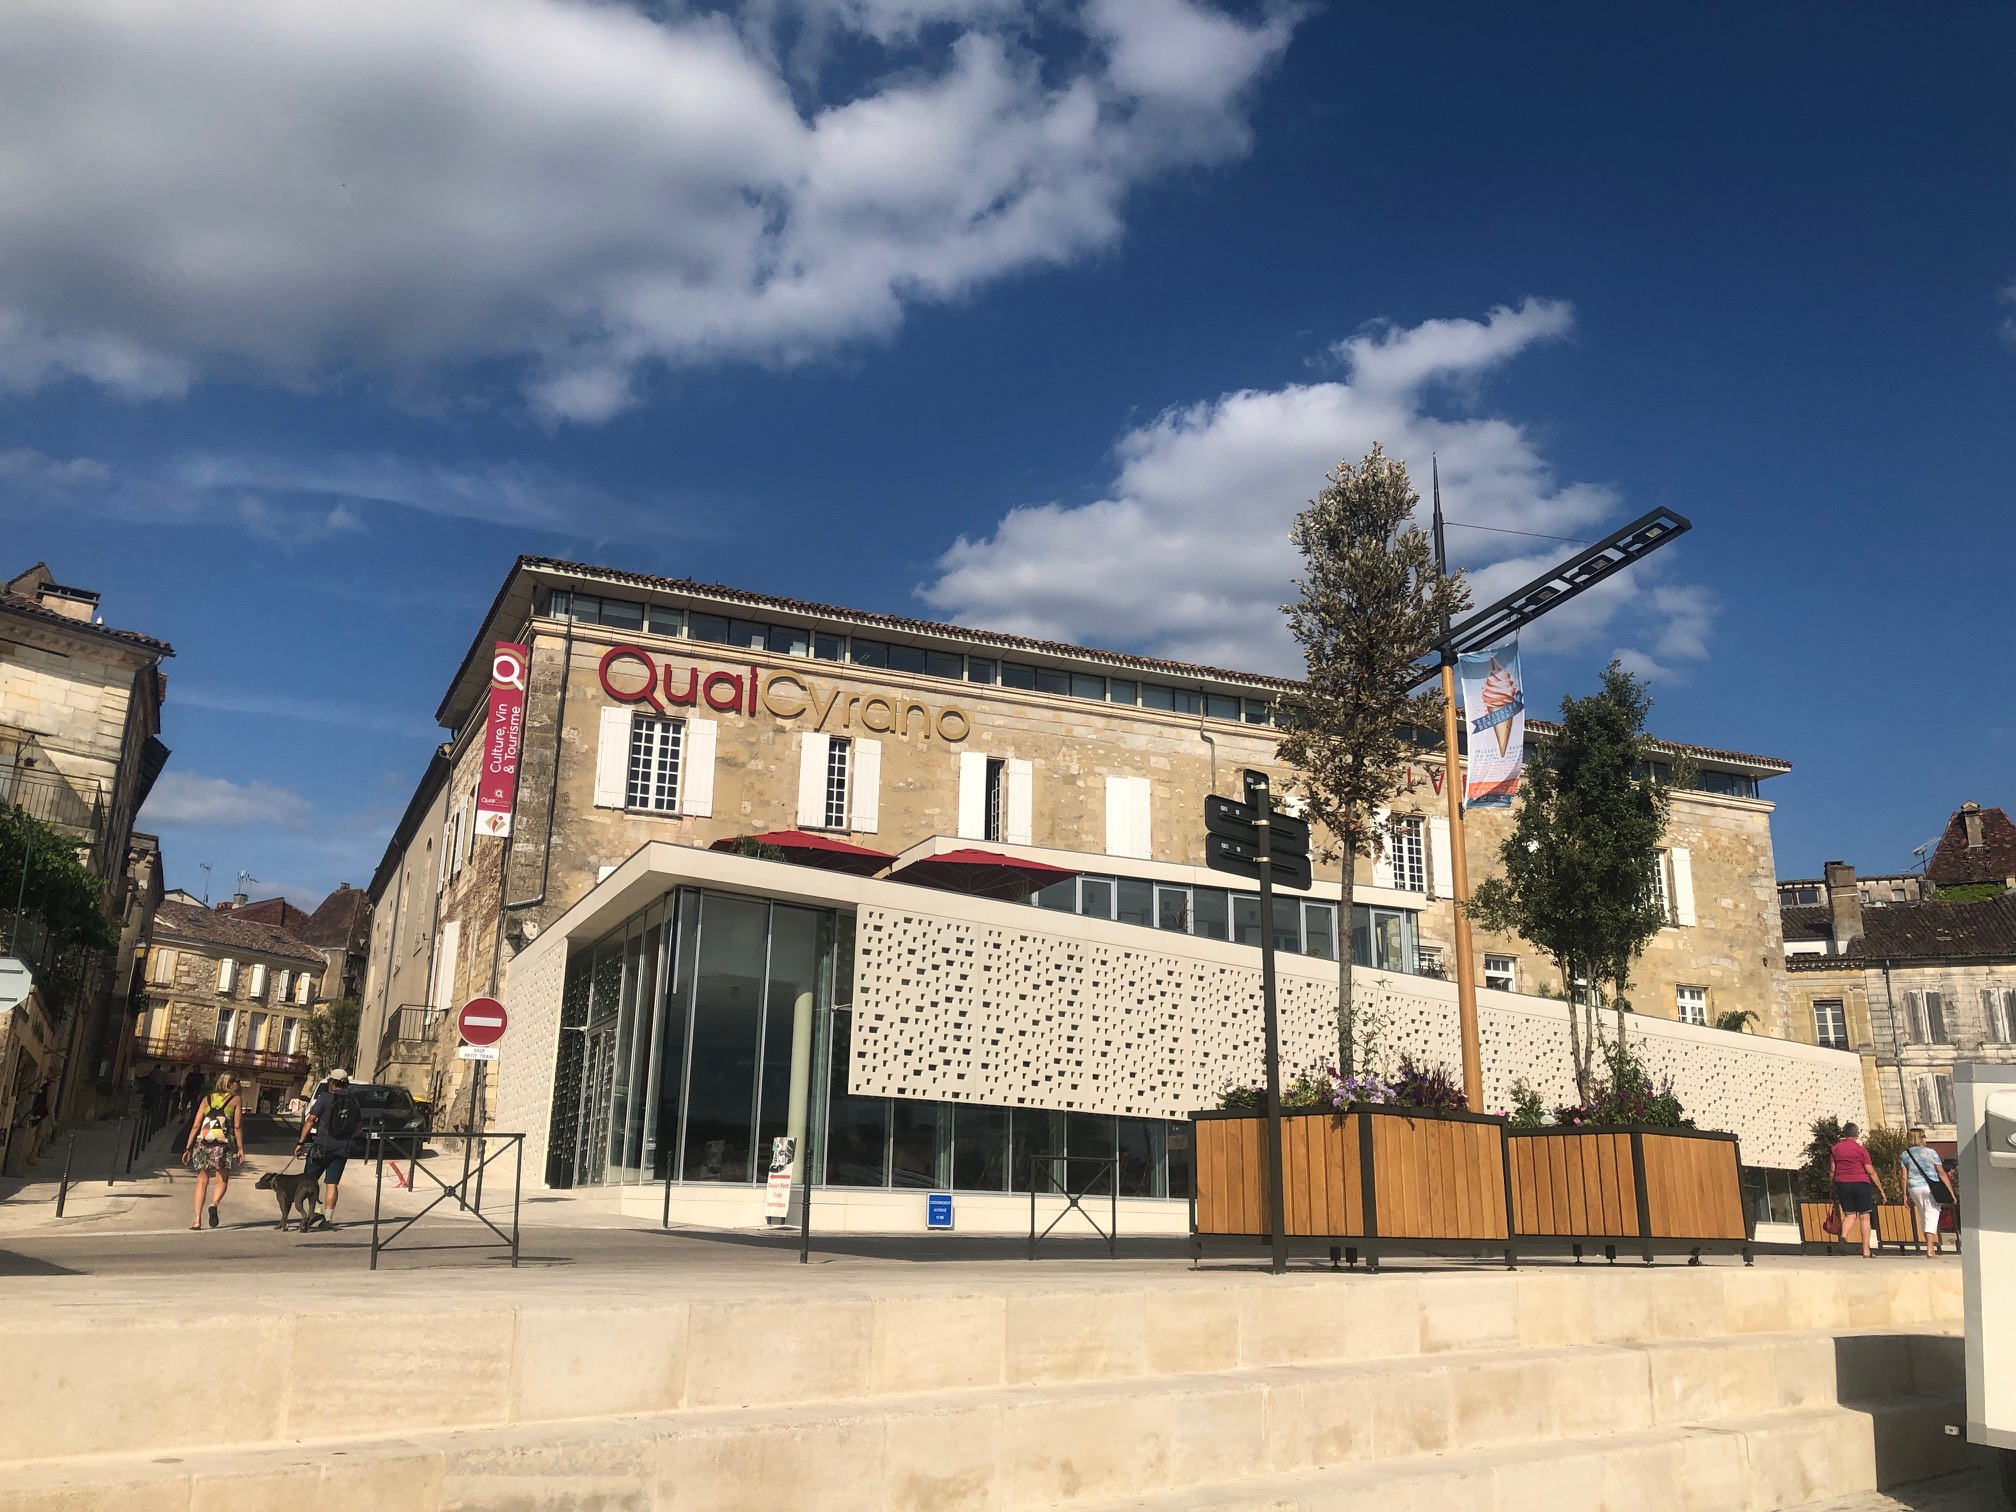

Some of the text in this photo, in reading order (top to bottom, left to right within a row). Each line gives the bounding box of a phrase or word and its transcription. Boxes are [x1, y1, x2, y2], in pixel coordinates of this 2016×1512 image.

[489, 703, 508, 773] Culture, Vin
[503, 706, 521, 774] & Tourisme
